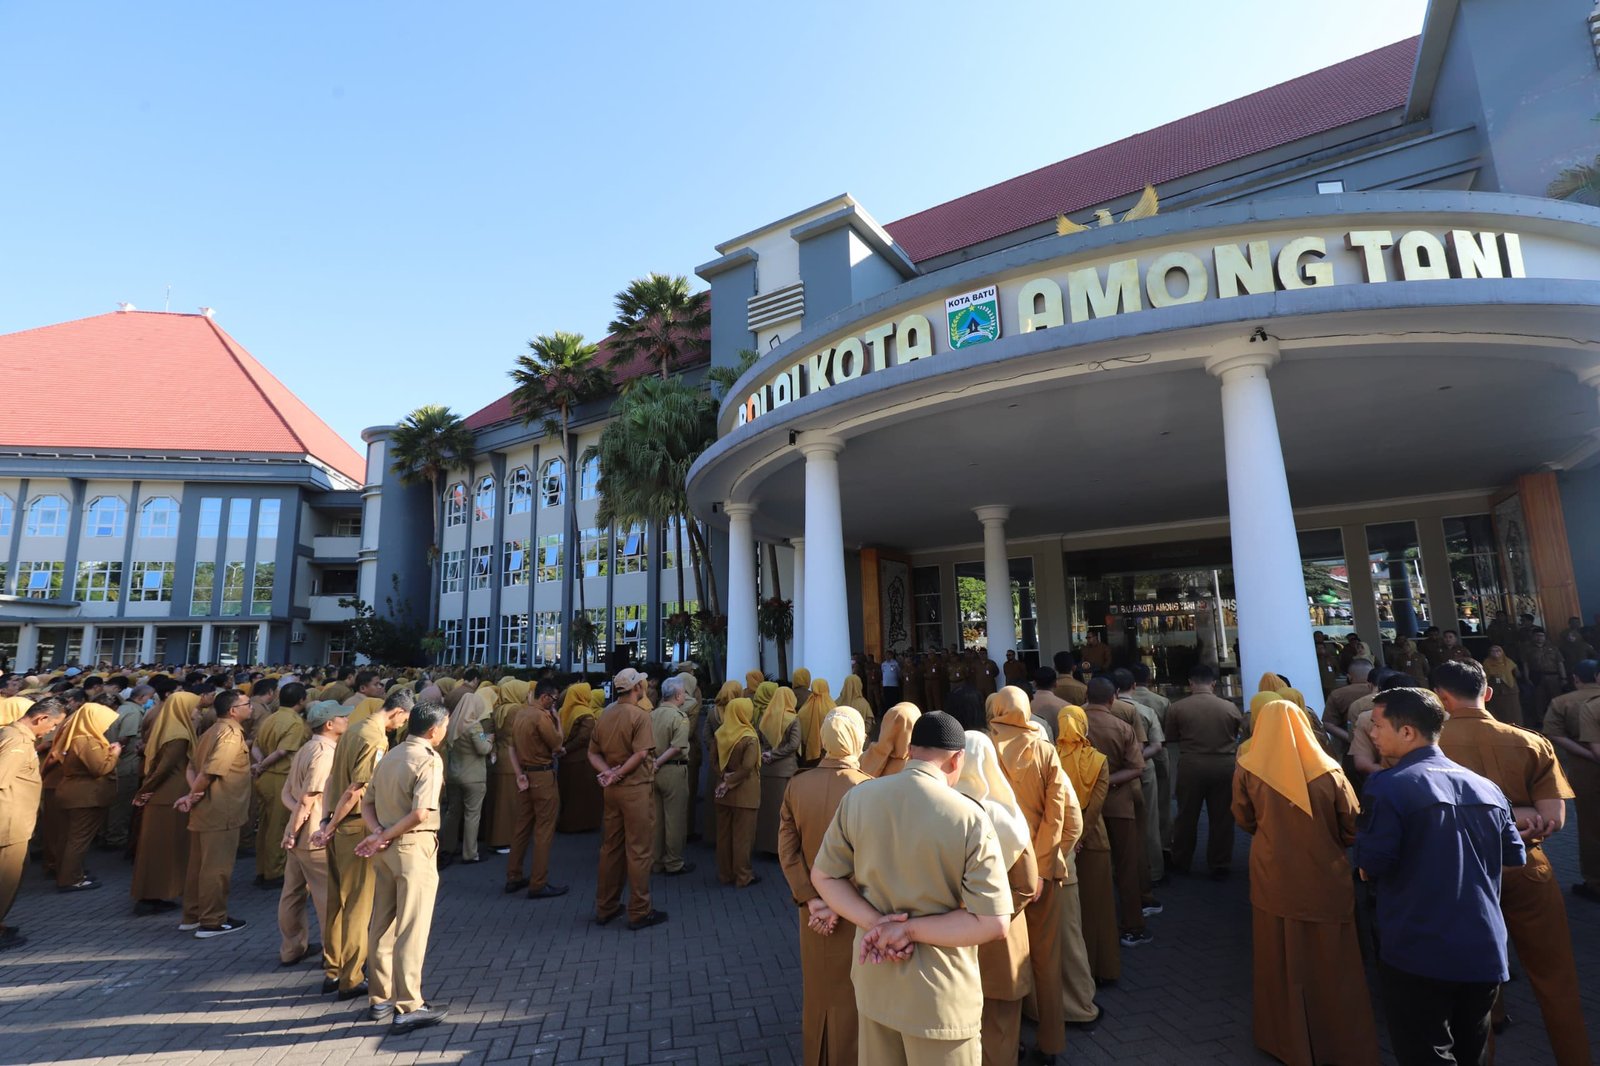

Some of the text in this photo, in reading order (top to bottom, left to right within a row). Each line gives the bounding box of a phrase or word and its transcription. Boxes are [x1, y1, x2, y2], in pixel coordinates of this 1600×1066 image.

[809, 315, 933, 394] KOTA
[1018, 237, 1334, 333] AMONG
[1345, 230, 1526, 282] TANI
[948, 289, 995, 308] KOTA BATU
